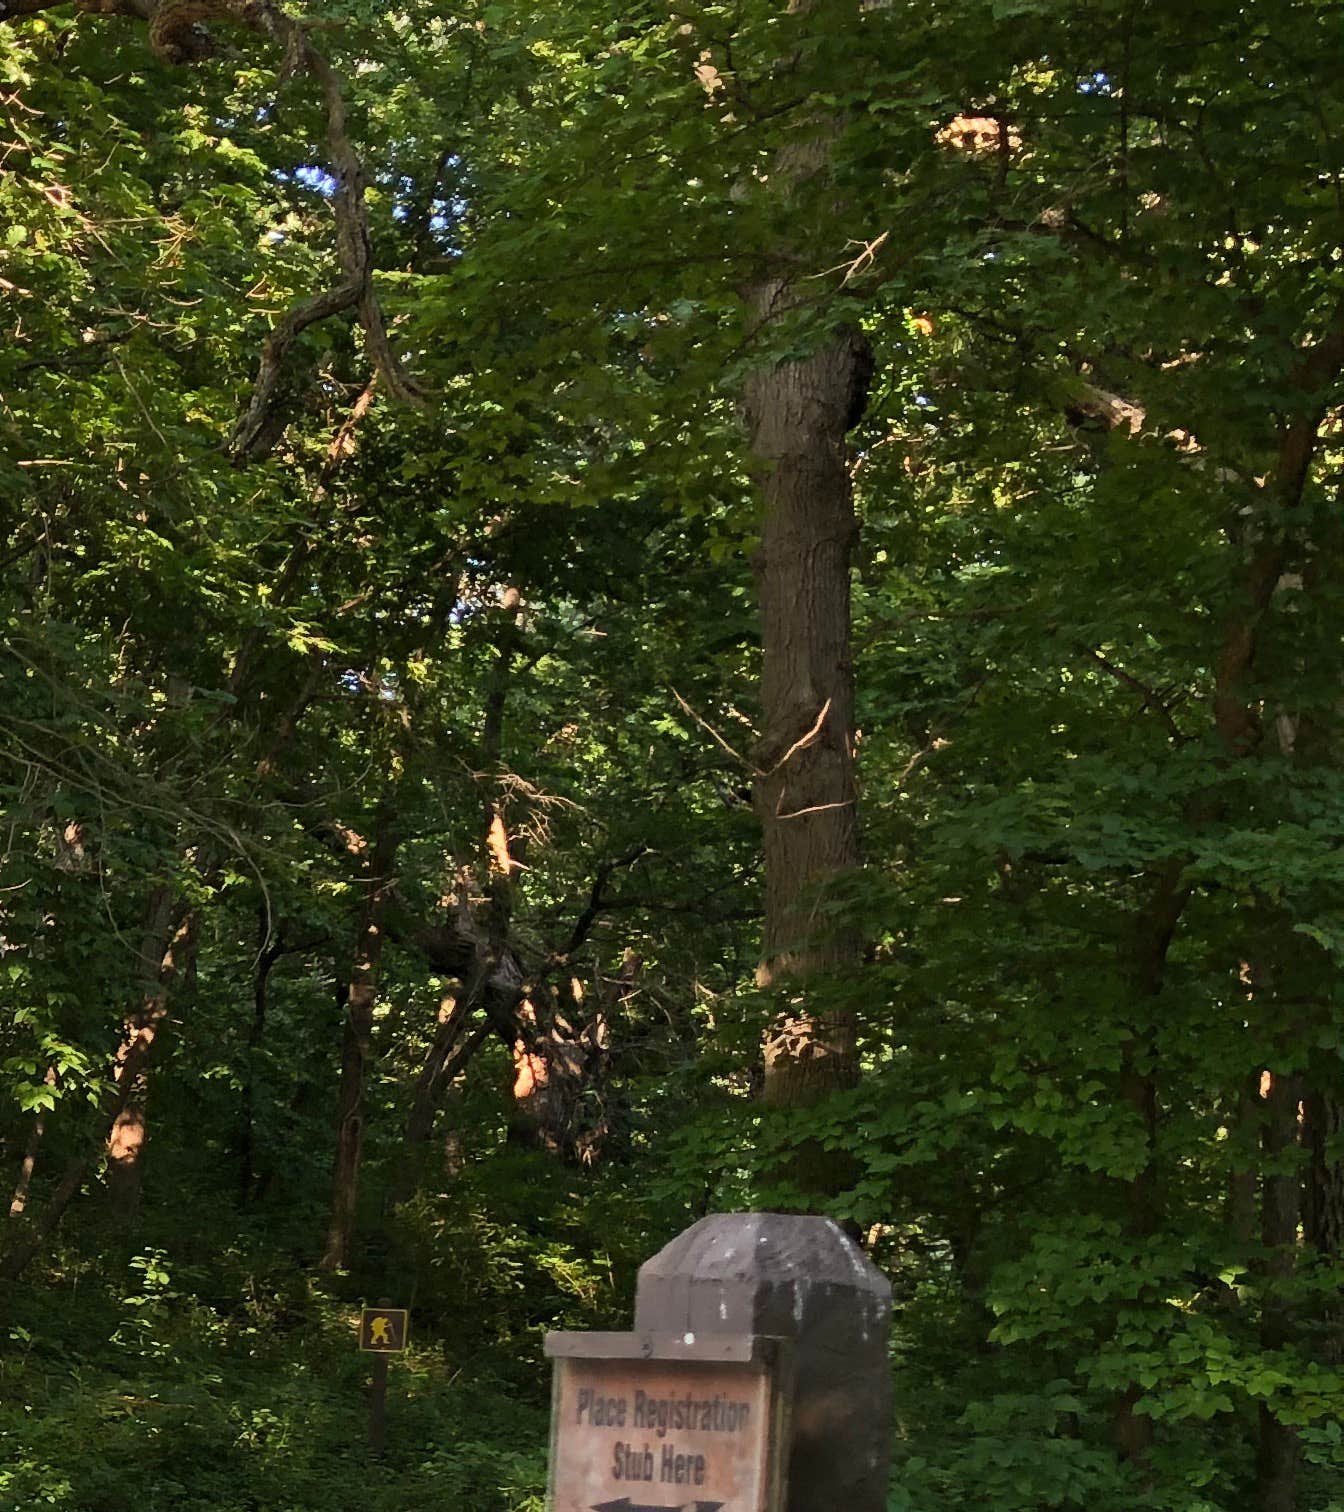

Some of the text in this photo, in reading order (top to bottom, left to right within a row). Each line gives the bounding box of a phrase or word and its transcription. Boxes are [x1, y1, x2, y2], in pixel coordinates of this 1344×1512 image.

[576, 1388, 750, 1437] Place Registration
[613, 1441, 705, 1485] Stub Here
